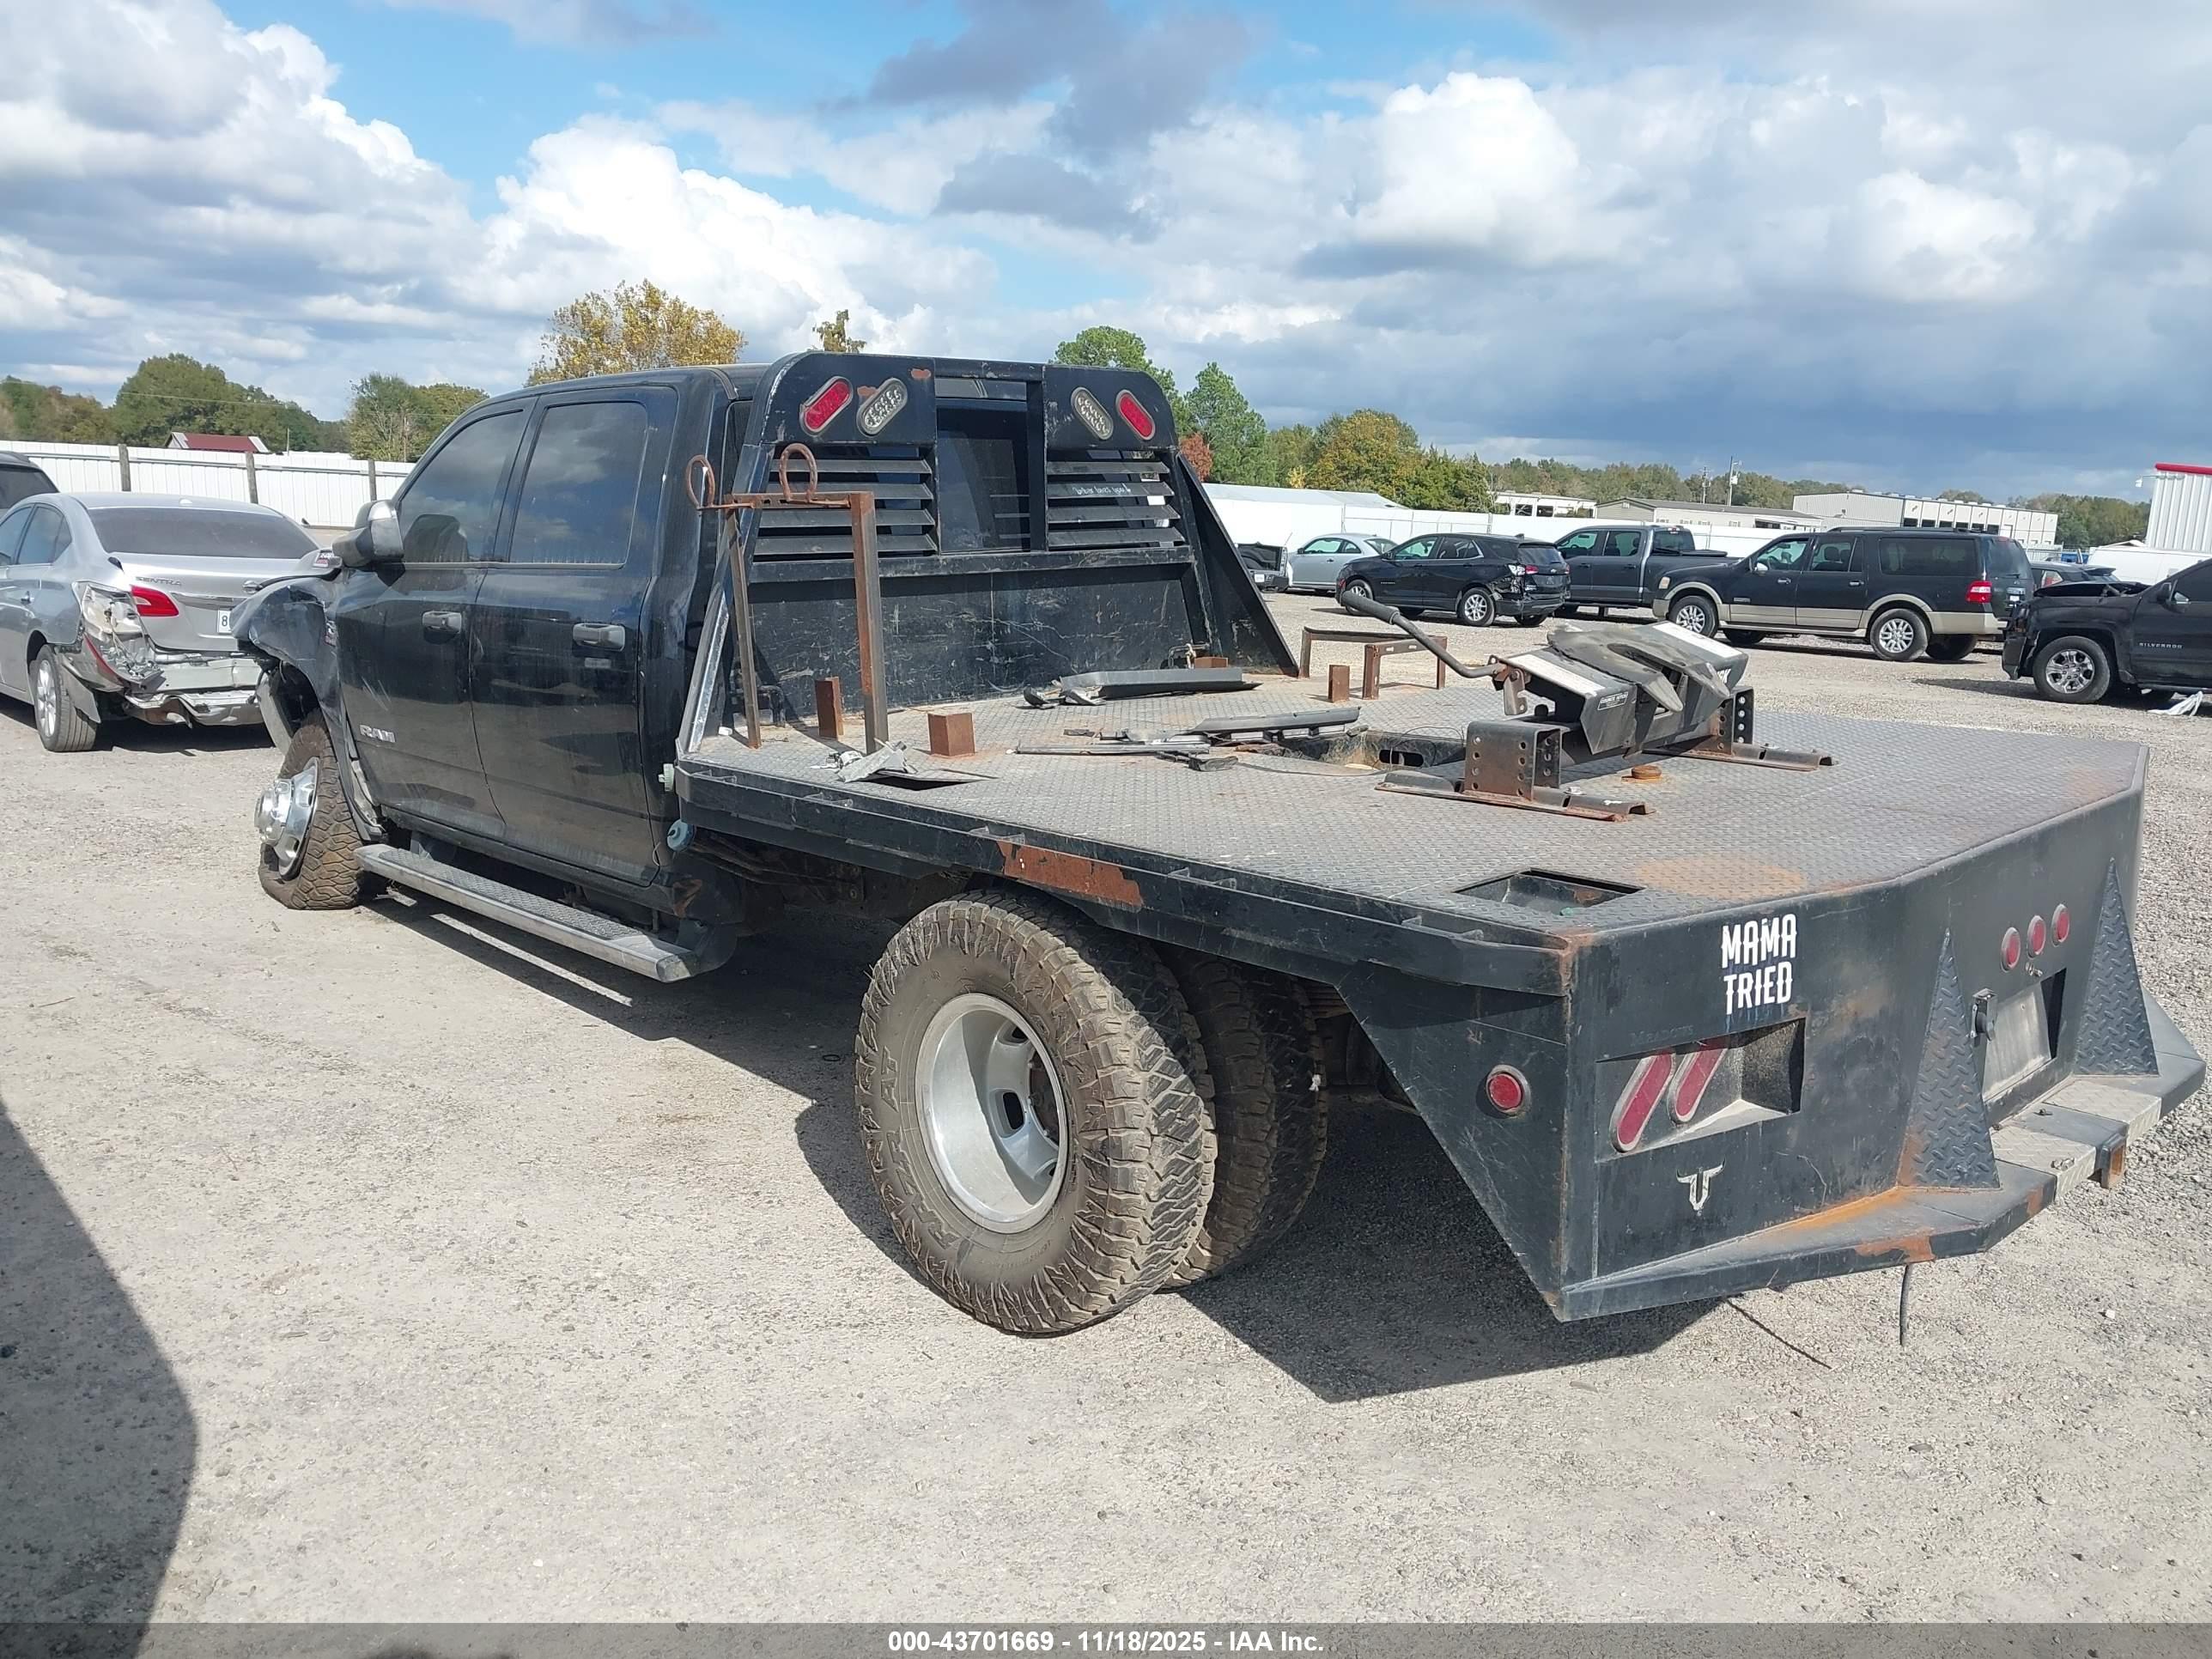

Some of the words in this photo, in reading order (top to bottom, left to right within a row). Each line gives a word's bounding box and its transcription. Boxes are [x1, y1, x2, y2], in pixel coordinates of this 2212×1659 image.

[136, 576, 181, 586] SENTRA
[359, 724, 396, 743] RAM
[1721, 913, 1797, 969] MAMA
[1723, 961, 1793, 1015] TRIED
